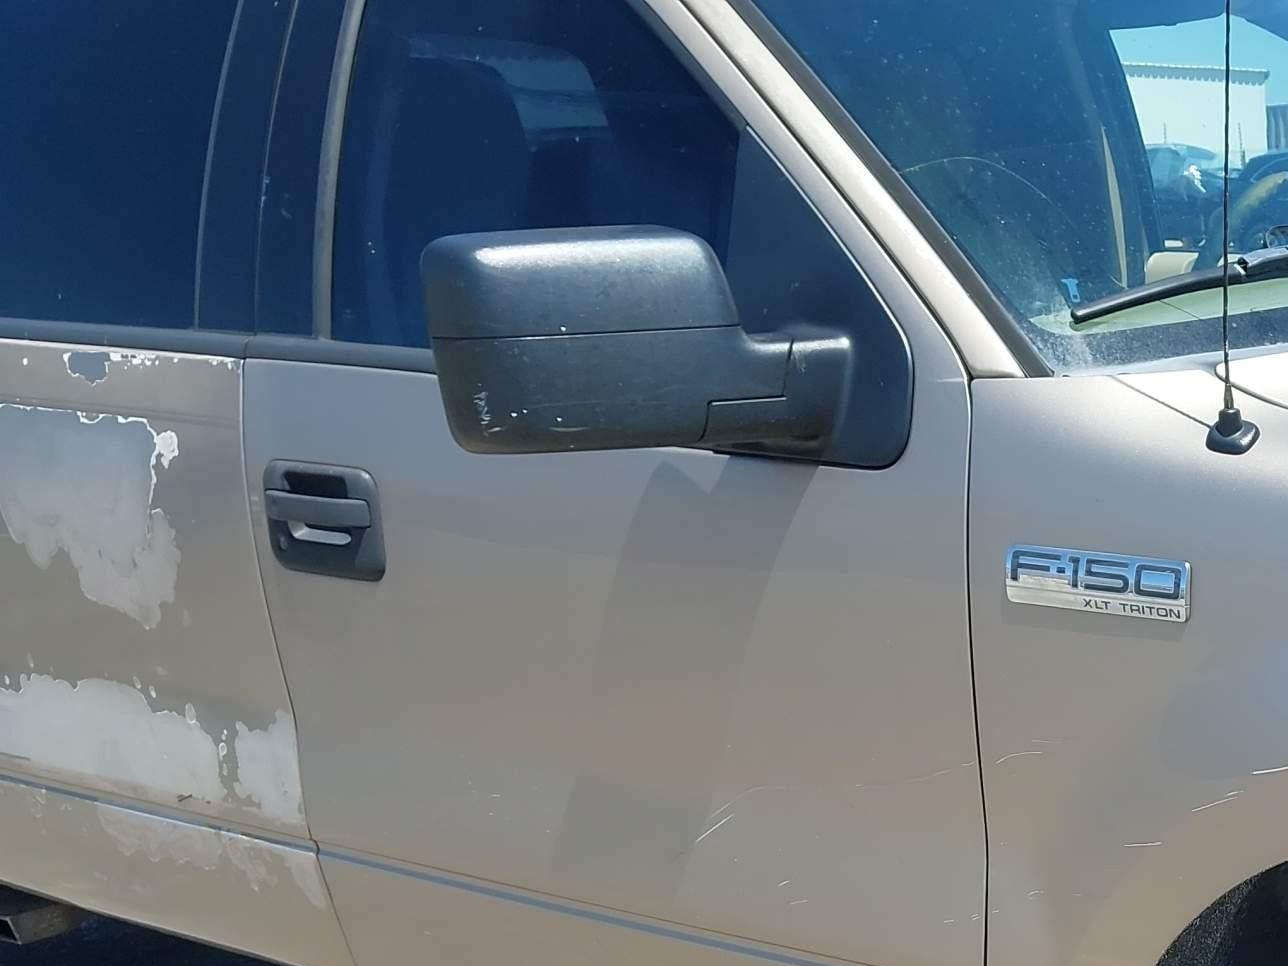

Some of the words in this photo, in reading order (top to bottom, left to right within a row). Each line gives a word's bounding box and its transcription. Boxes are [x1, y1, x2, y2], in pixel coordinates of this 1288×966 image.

[1010, 550, 1182, 600] F-150
[1083, 598, 1111, 611] XLT
[1119, 603, 1181, 620] TRITON
